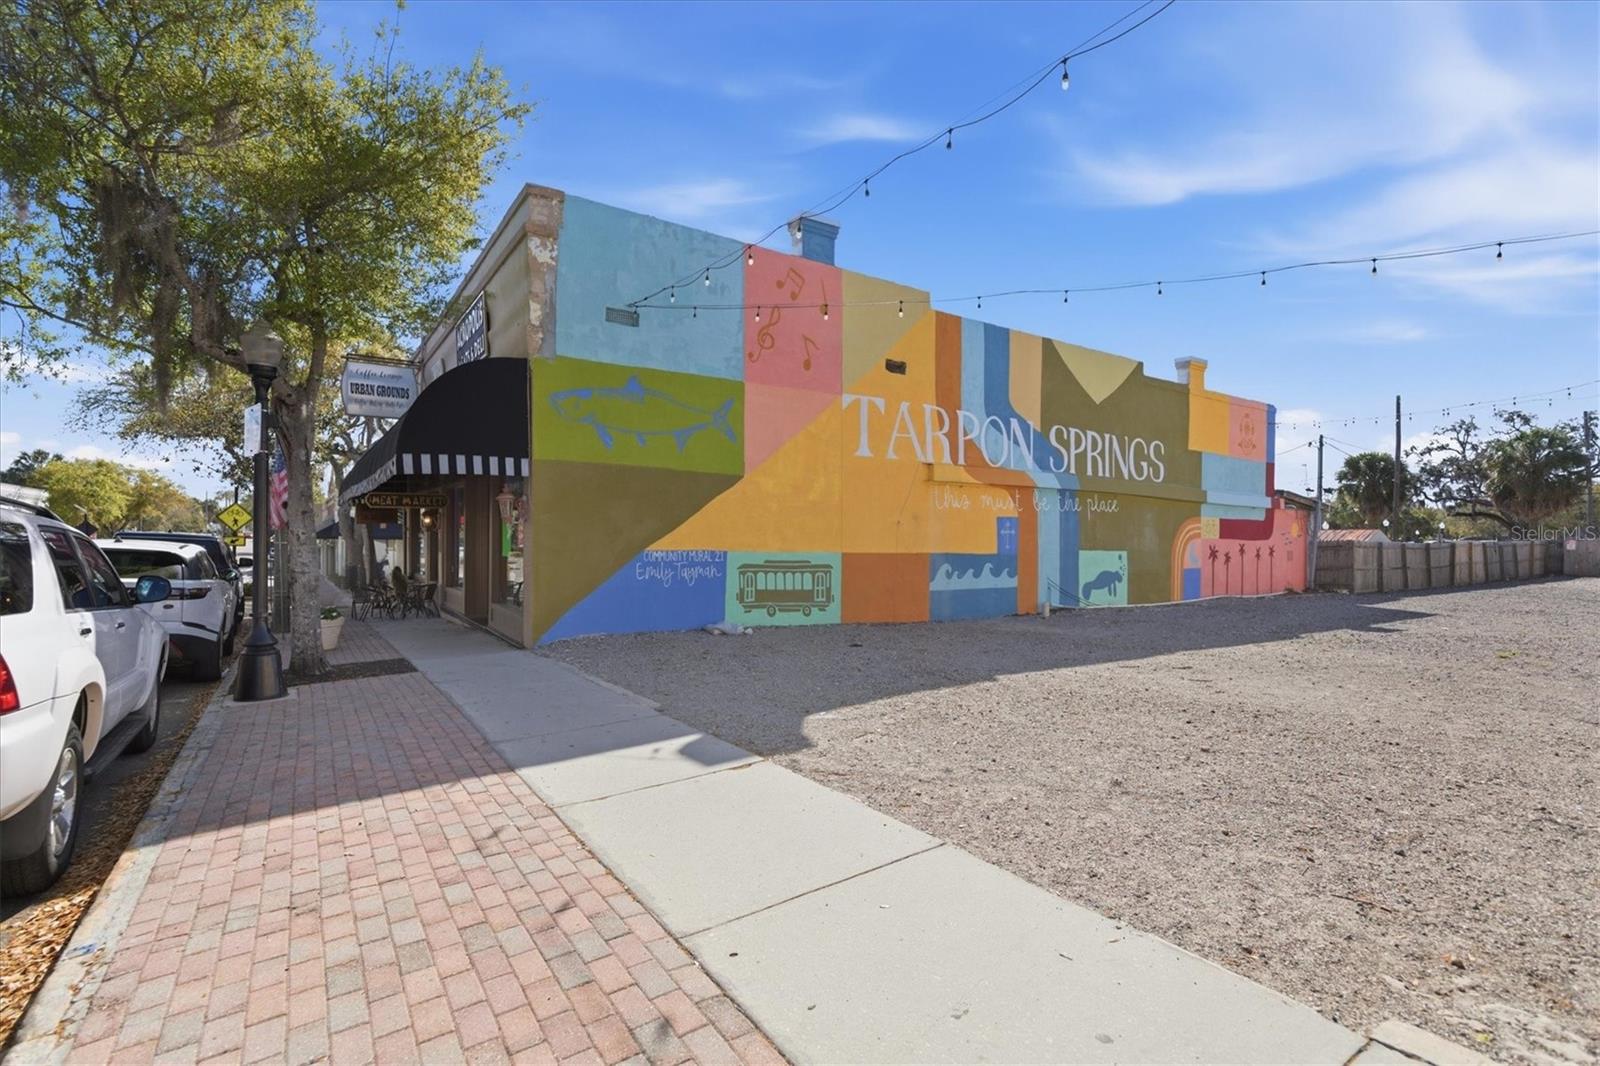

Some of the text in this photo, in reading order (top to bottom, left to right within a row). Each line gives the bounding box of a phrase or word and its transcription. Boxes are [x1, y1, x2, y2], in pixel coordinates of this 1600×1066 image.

[474, 334, 484, 358] DELI
[350, 382, 410, 400] URBAN GROUNDS
[842, 394, 1165, 484] TARPON SPRINGS
[371, 495, 399, 506] MEAT
[934, 487, 1120, 520] this must be the place
[643, 551, 688, 562] COMMUNITY
[689, 551, 712, 561] MURAL
[636, 561, 722, 587] Emily Tayman
